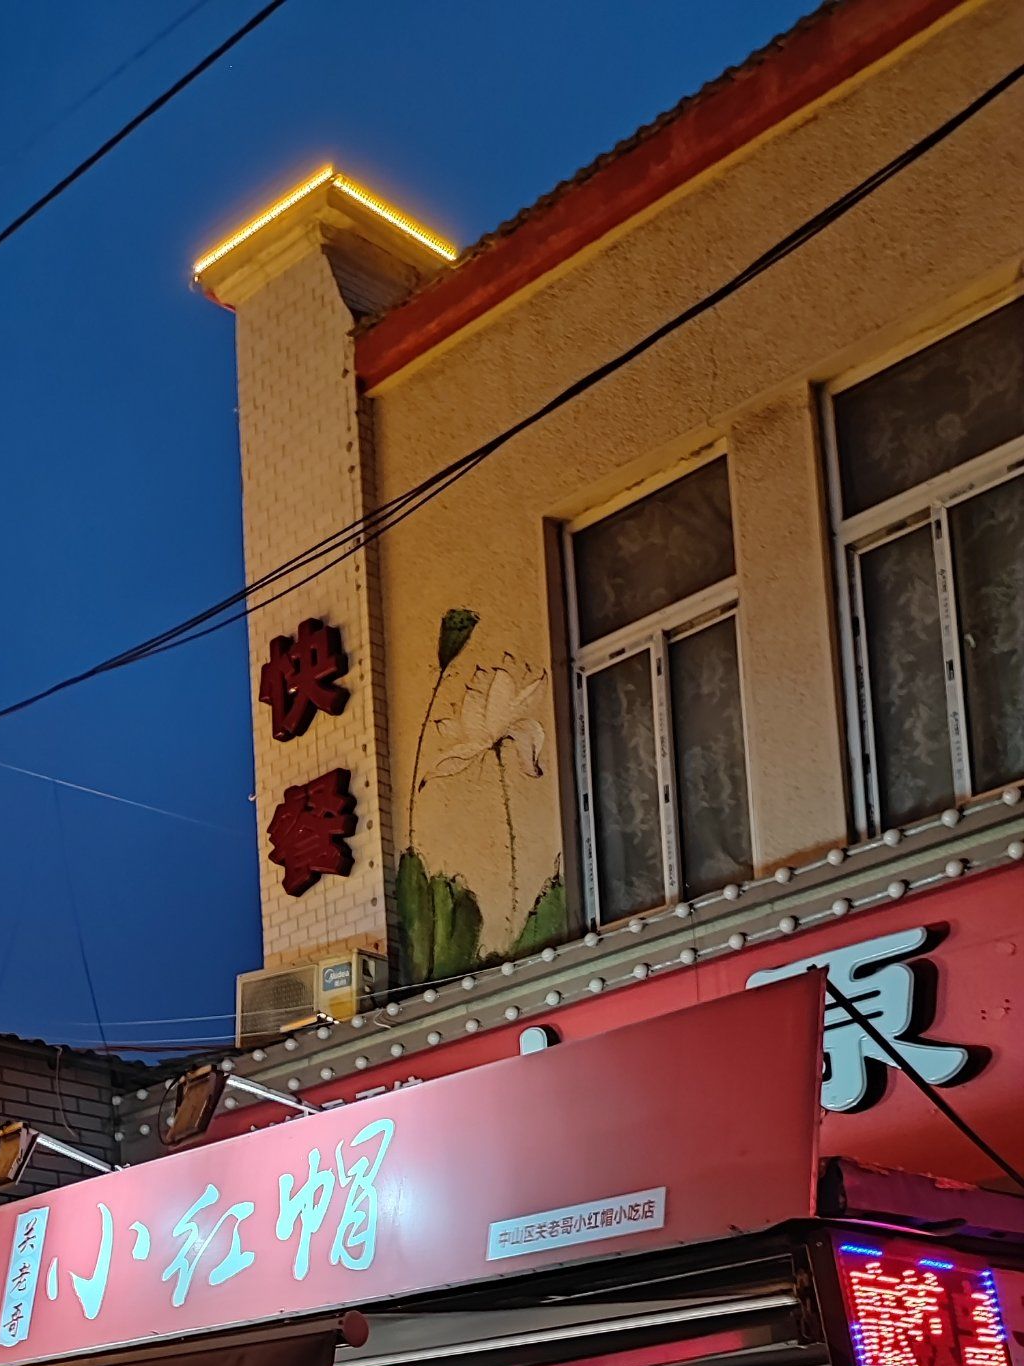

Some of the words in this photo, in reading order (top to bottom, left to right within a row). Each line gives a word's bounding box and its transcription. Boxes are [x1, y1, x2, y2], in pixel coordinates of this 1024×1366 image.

[259, 617, 358, 898] 快餐
[2, 1221, 39, 1339] 关老哥
[47, 1117, 396, 1320] 小红帽
[498, 1200, 656, 1248] 中山区关老哥小红帽小吃店
